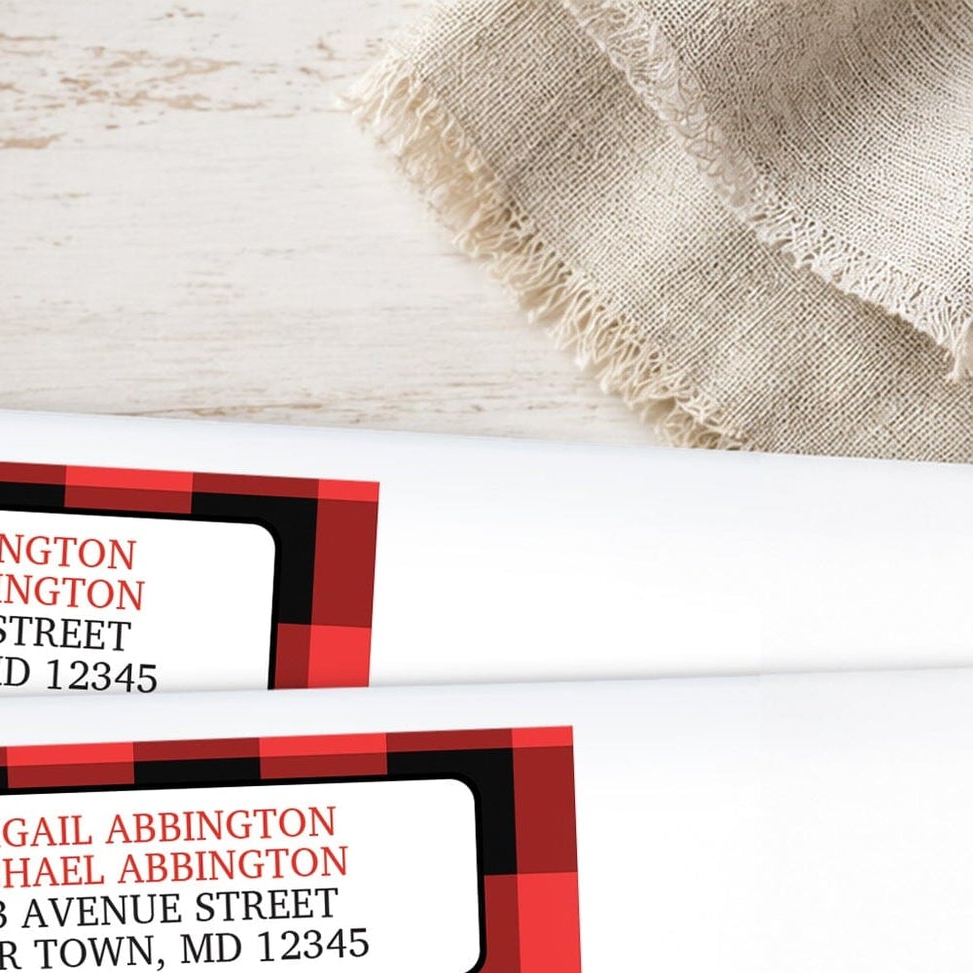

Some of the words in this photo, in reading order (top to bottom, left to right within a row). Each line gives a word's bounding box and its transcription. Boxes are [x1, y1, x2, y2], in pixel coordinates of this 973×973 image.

[46, 658, 158, 694] 12345
[104, 805, 337, 845] ABBINGTON
[117, 845, 349, 884] ABBINGTON
[20, 893, 183, 929] AVENUE
[195, 887, 339, 922] STREET
[33, 934, 166, 973] TOWN,
[179, 932, 242, 964] MD
[257, 927, 370, 962] 12345
